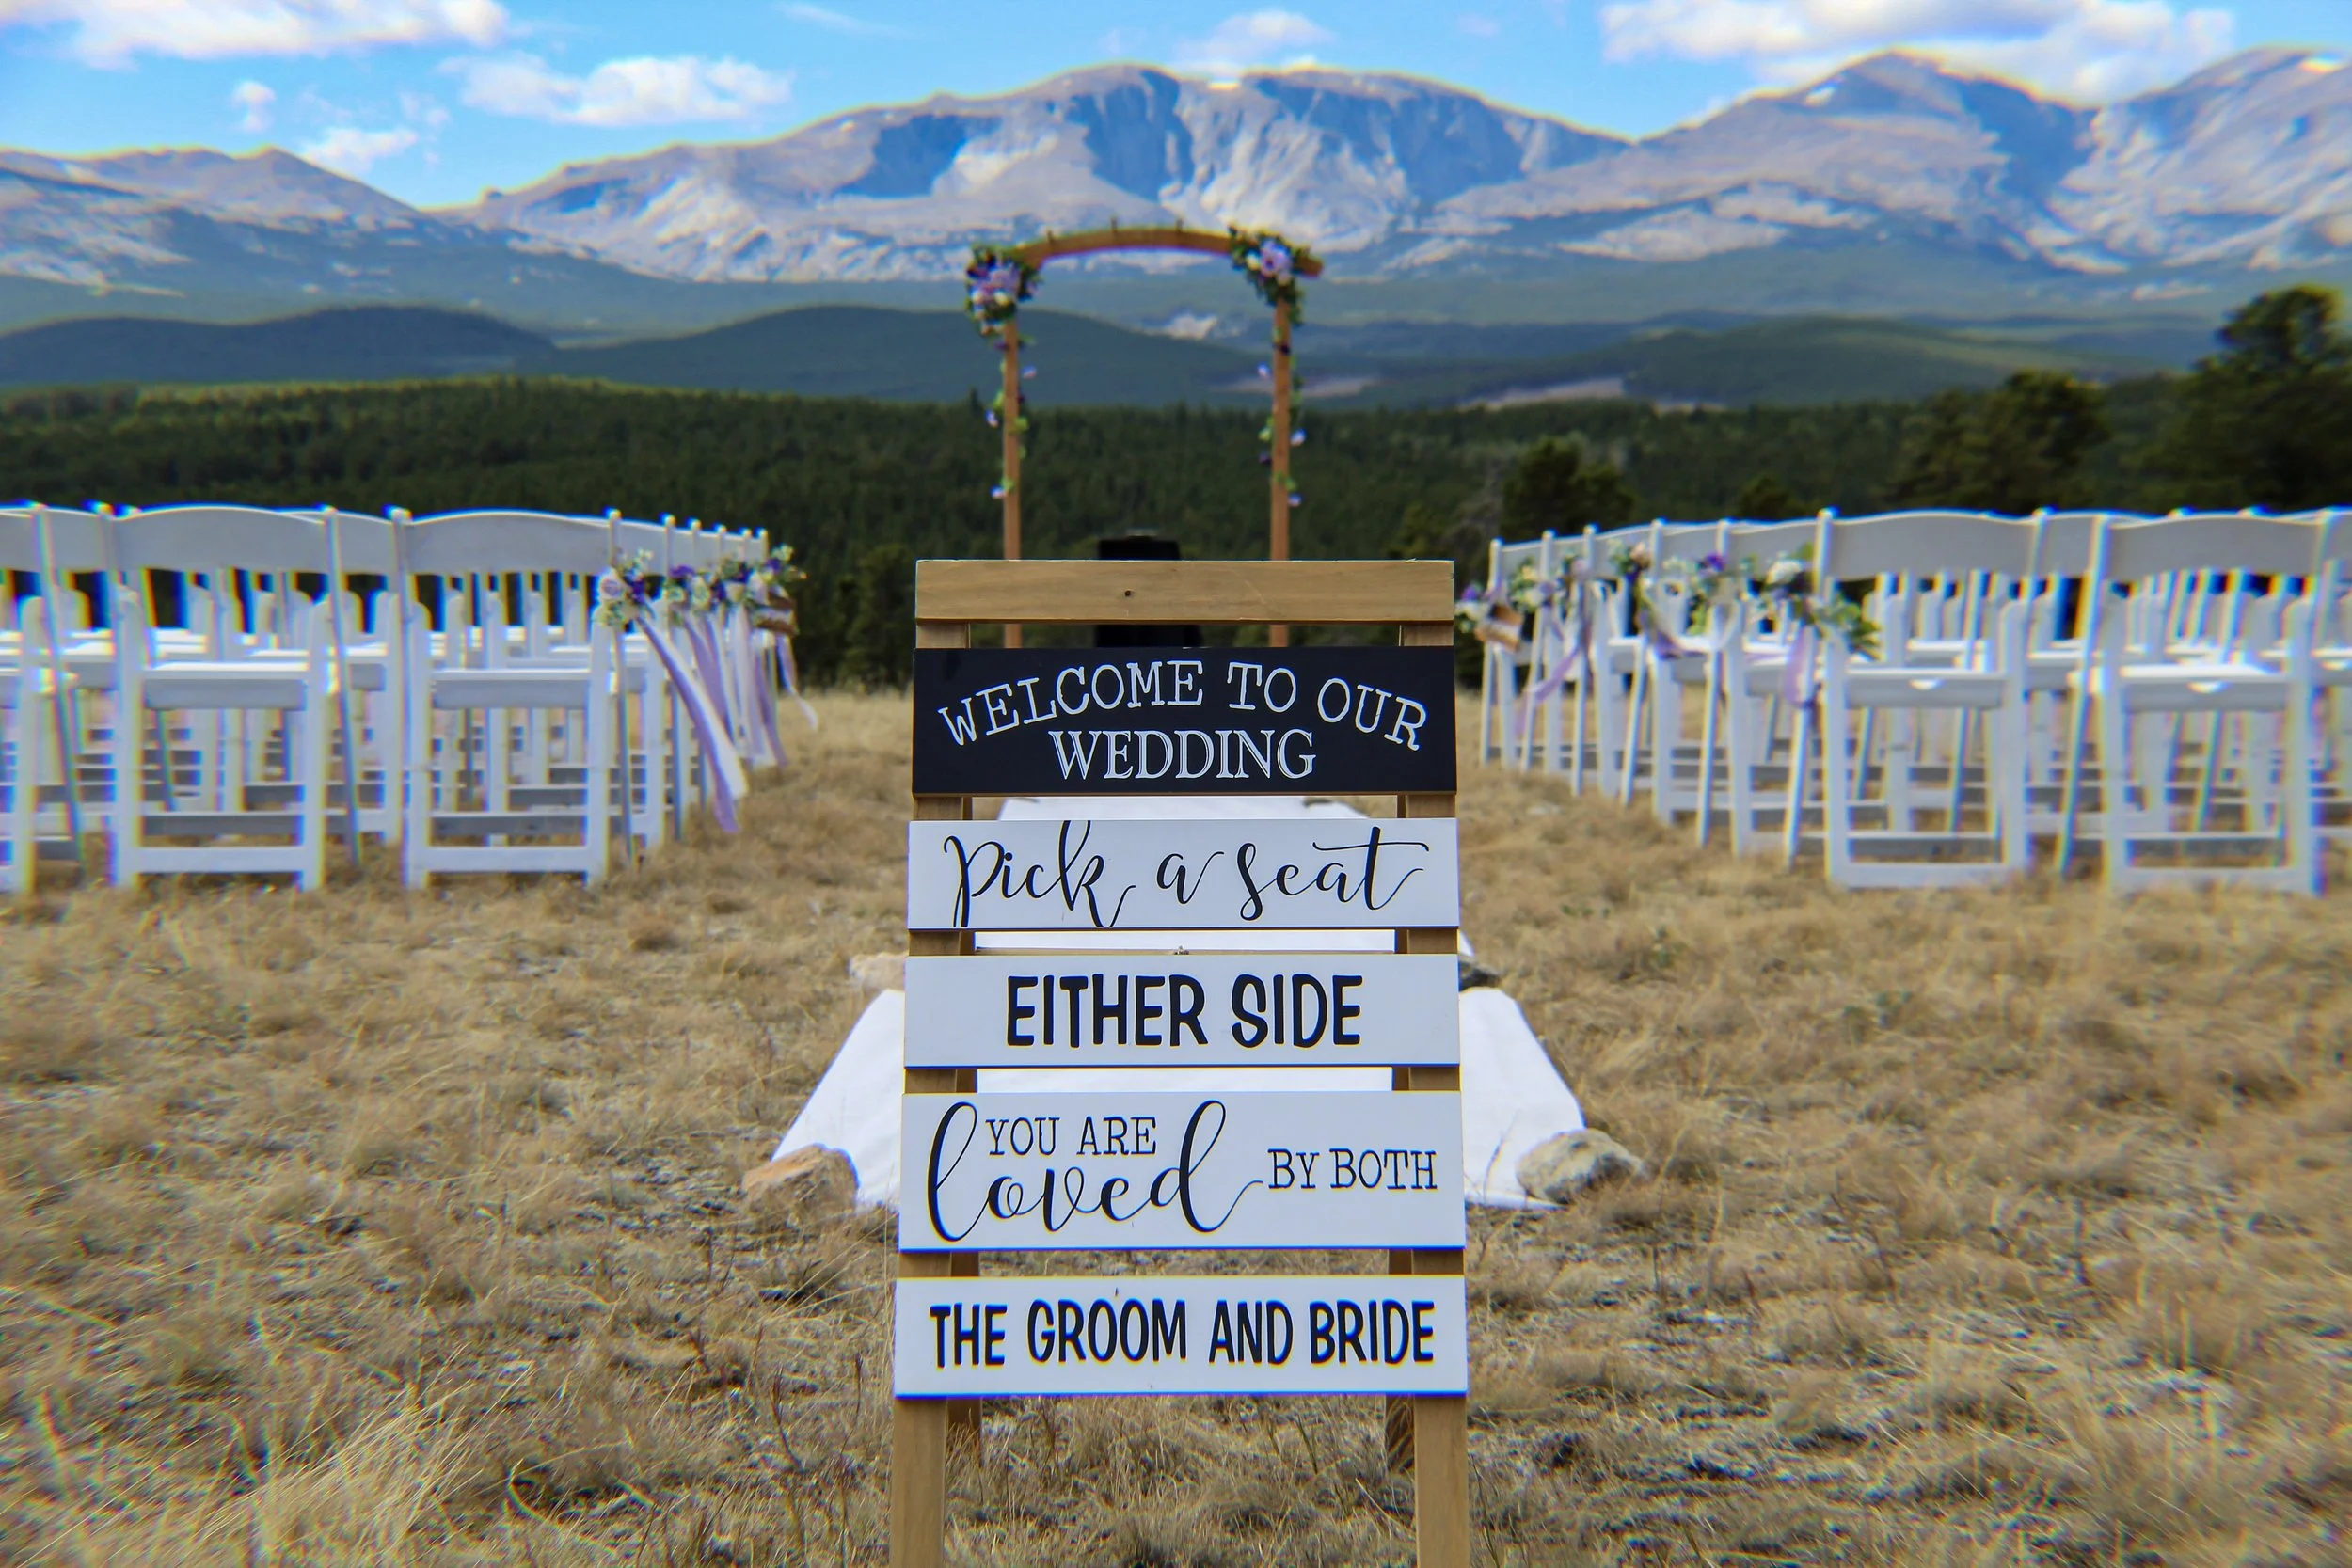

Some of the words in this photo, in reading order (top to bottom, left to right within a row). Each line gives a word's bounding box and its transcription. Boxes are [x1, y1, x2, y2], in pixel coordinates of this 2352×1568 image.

[937, 660, 1203, 746] WELCOME
[1226, 661, 1297, 713] TO
[1317, 677, 1427, 752] OUR
[1047, 728, 1317, 781] WEDDING
[1156, 850, 1225, 905] a
[1236, 826, 1430, 921] seat
[1007, 974, 1209, 1048] EITHER
[1231, 973, 1363, 1049] SIDE
[927, 1100, 1263, 1243] loved
[985, 1117, 1060, 1156] YOU
[1076, 1116, 1157, 1156] ARE
[1267, 1148, 1320, 1190] BY
[1328, 1148, 1438, 1190] BOTH
[930, 1303, 1008, 1369] THE
[1027, 1298, 1187, 1364] GROOM
[1208, 1299, 1294, 1366] AND
[1309, 1299, 1435, 1365] BRIDE
